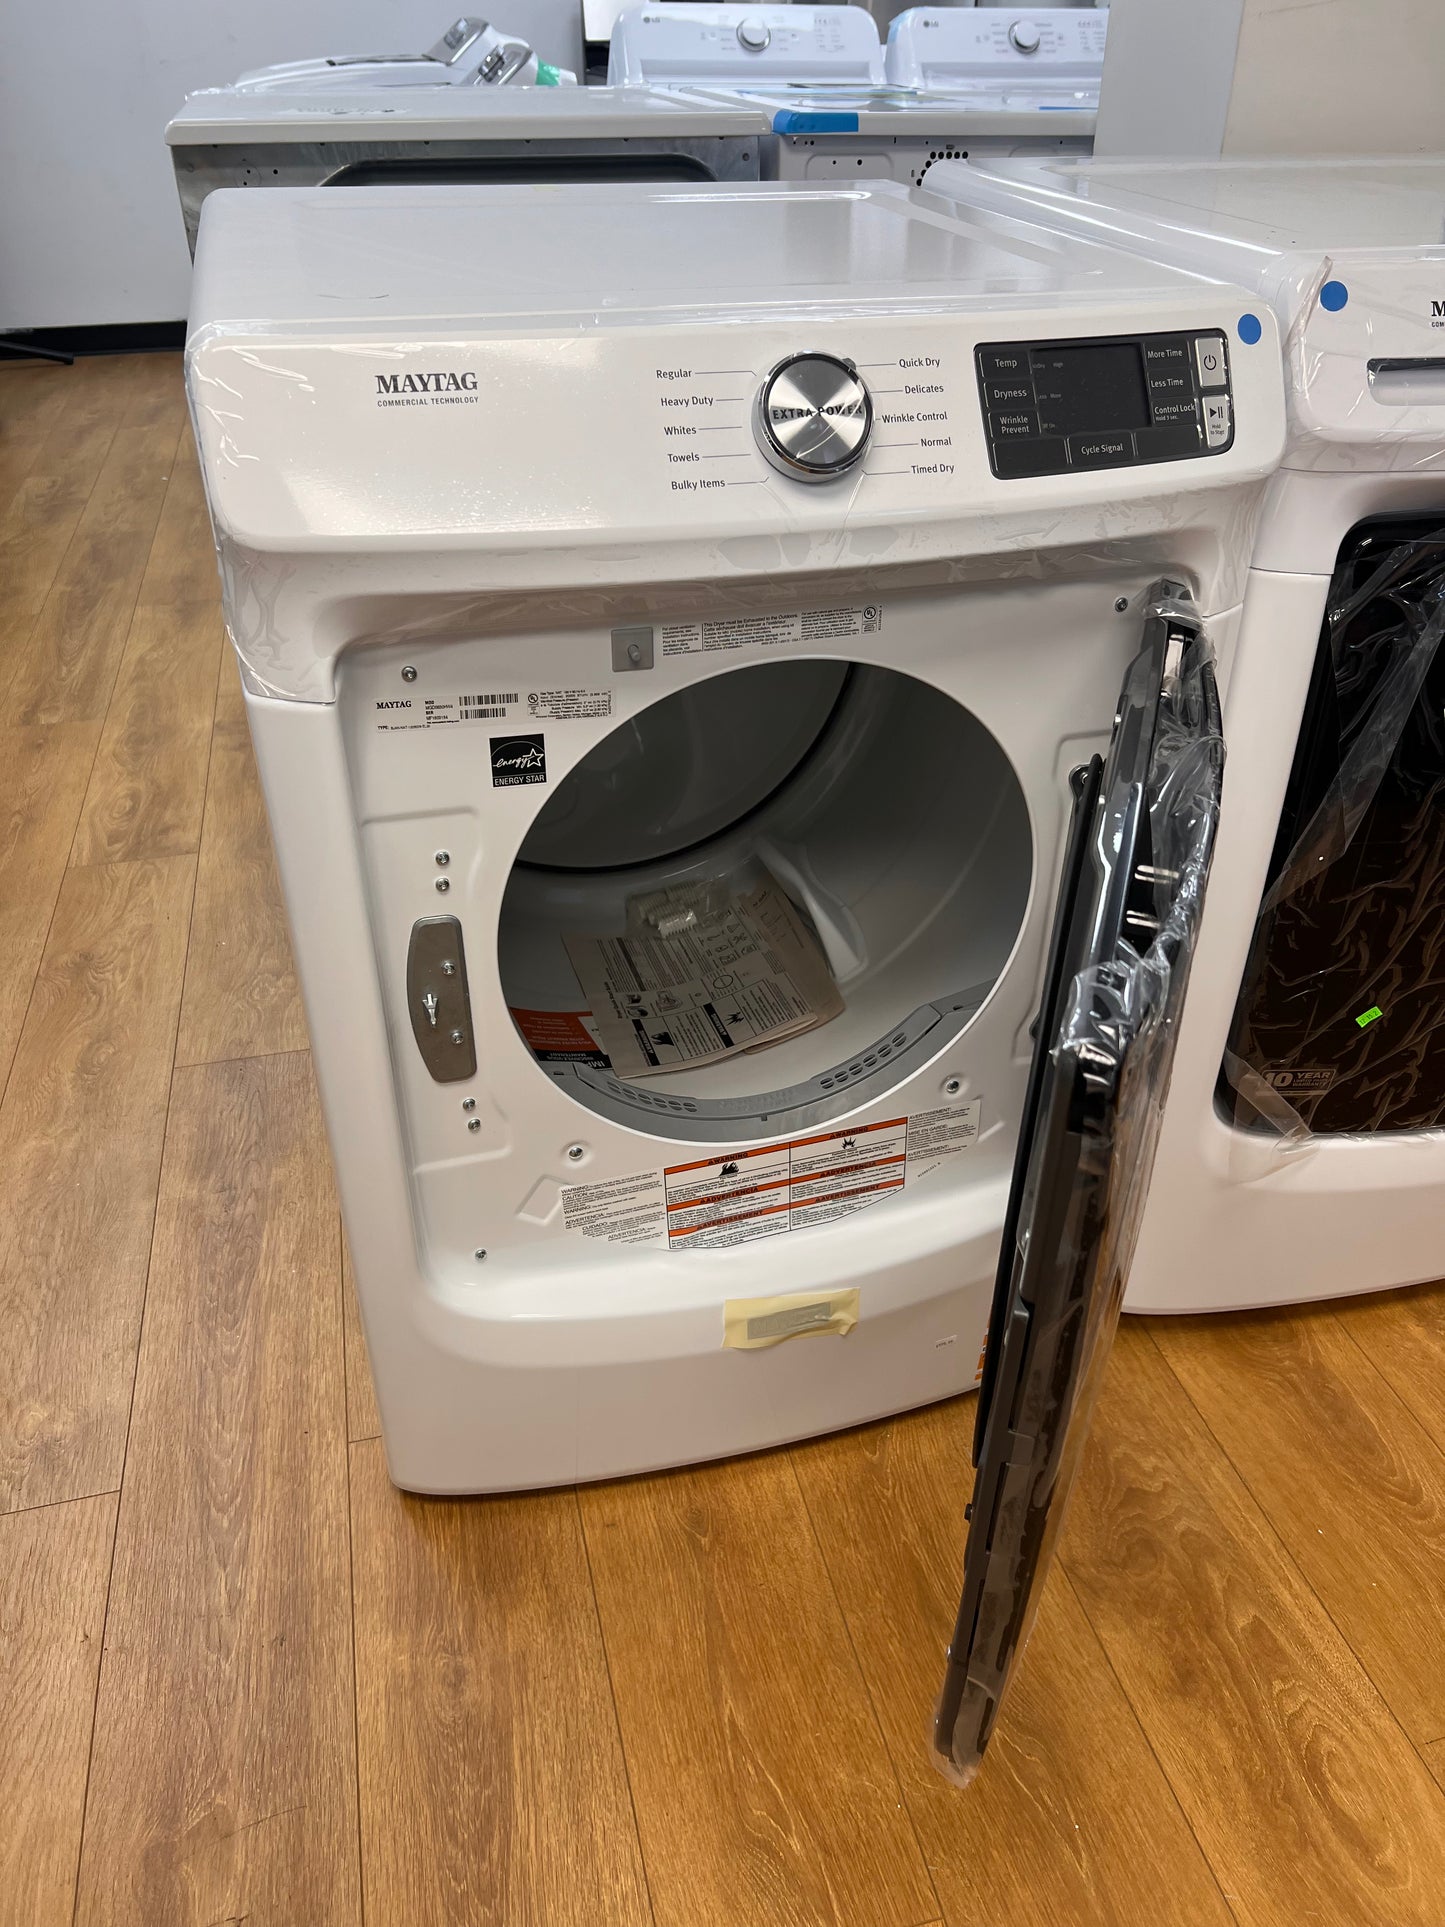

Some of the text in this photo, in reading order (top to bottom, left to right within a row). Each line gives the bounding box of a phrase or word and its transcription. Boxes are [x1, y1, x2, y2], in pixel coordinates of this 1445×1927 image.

[1148, 349, 1183, 358] More Time
[899, 356, 940, 369] Quick Dry
[995, 358, 1017, 370] Temp
[656, 368, 692, 381] Regular
[375, 372, 478, 394] MAYTAG
[1151, 377, 1184, 387] Less Time
[904, 383, 944, 395] Delicates
[994, 388, 1027, 399] Dryness
[377, 396, 479, 407] COMMERCIAL TECHNOLOGY
[660, 394, 714, 408] Heavy Duty
[773, 404, 863, 420] EXTRA POWER
[1155, 403, 1196, 415] Control Lock
[882, 411, 948, 424] Wrinkle Control
[1000, 415, 1028, 424] Wrinkle
[664, 425, 697, 436] Whites
[1001, 425, 1030, 435] Prevent
[920, 436, 952, 448] Normal
[1081, 443, 1124, 456] Cycle Signal
[667, 452, 700, 463] Towels
[911, 462, 955, 475] Timed Dry
[671, 477, 725, 491] Bulky Items
[376, 701, 412, 710] MAYTAG
[493, 757, 528, 769] energy
[494, 774, 545, 786] ENERGY STAR
[1264, 1072, 1294, 1087] 10
